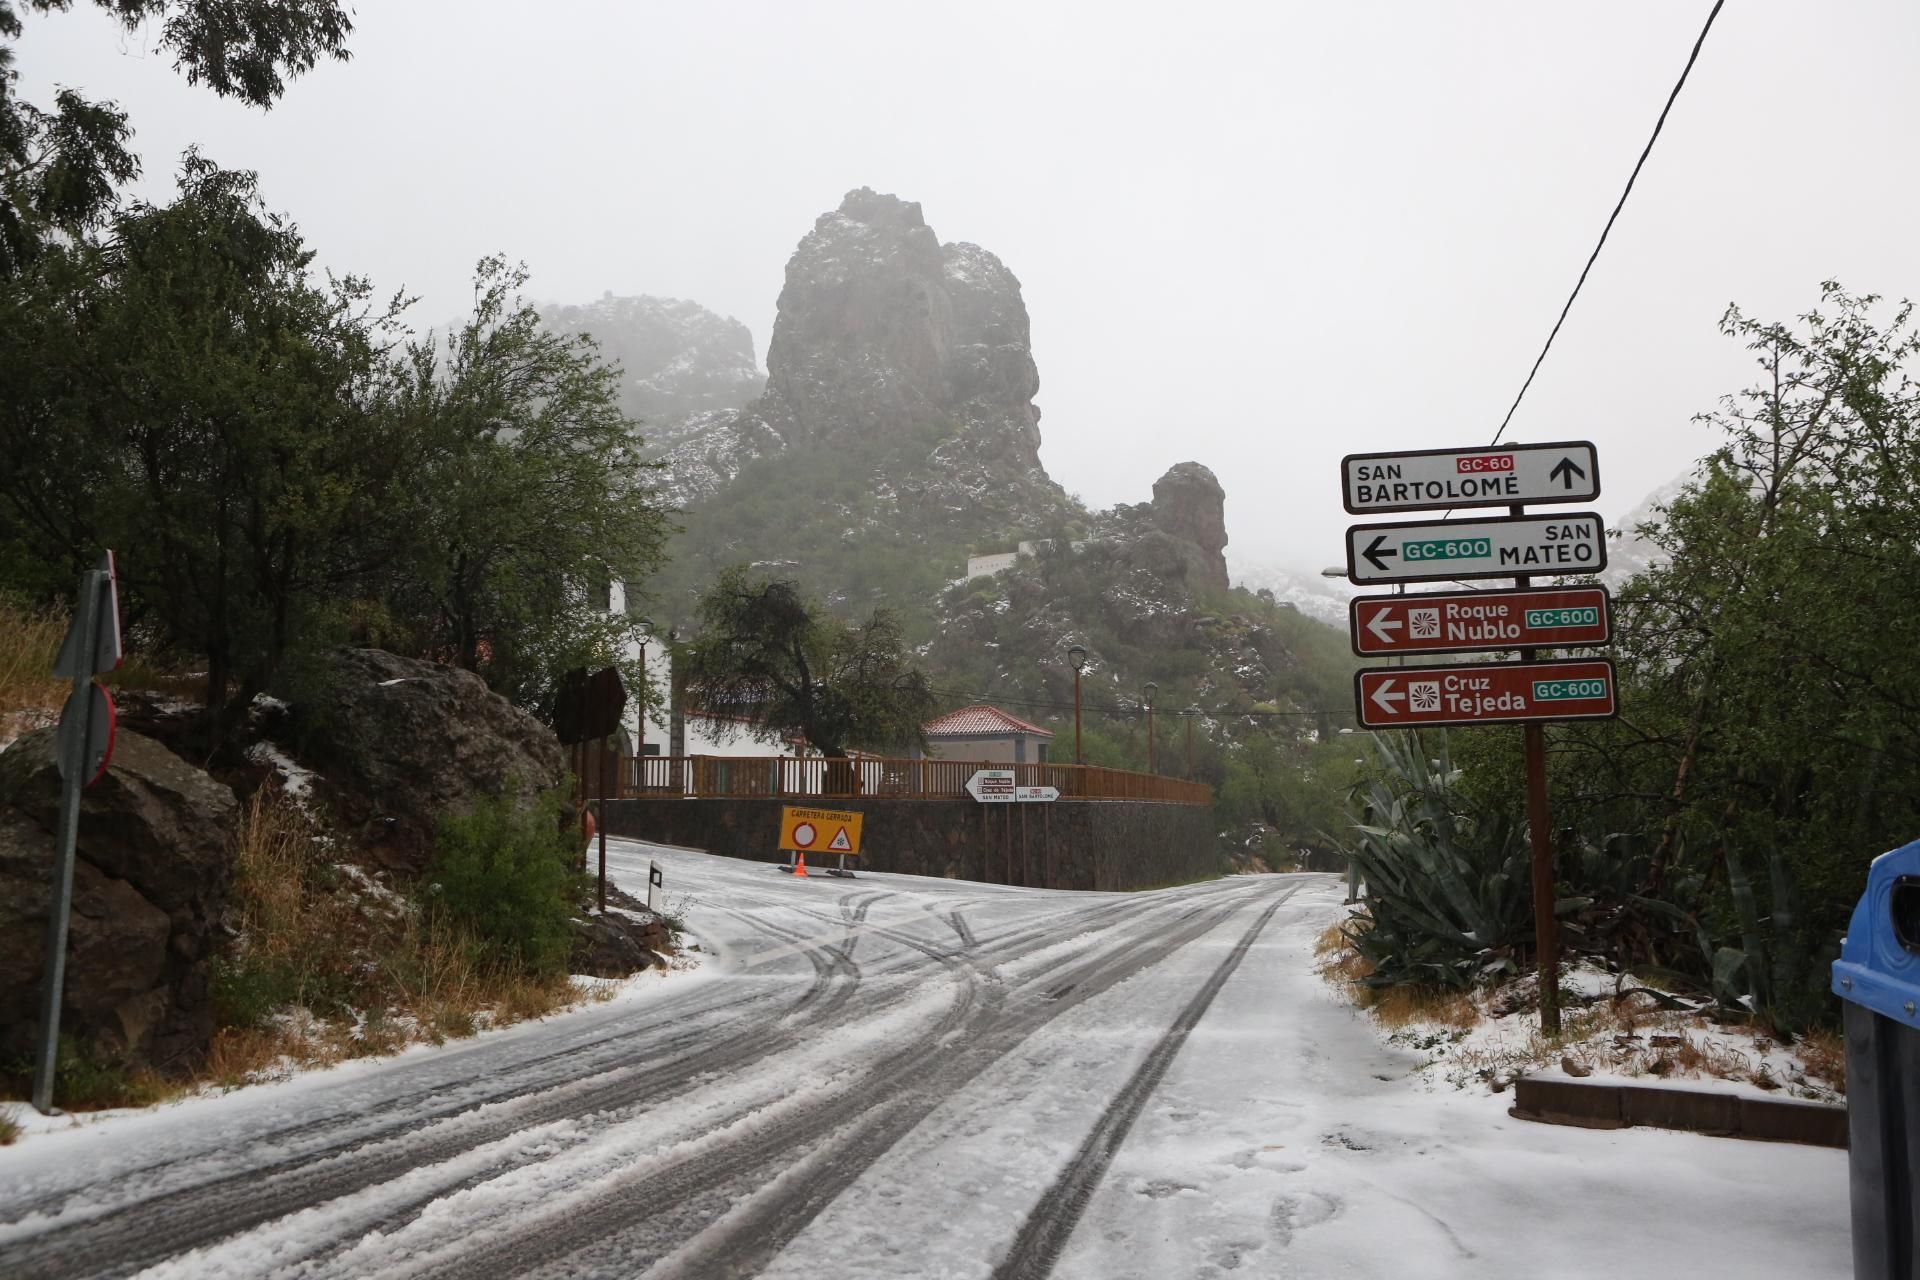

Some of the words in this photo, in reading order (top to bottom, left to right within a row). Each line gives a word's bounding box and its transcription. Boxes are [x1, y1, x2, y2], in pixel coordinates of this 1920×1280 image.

[1357, 464, 1402, 481] SAN
[1459, 457, 1512, 471] GC-60
[1357, 473, 1520, 503] BARTOLOMÉ
[1545, 524, 1590, 541] SAN
[1406, 541, 1489, 559] GC-600
[1500, 543, 1592, 566] MATEO
[1446, 603, 1509, 620] Roque
[1529, 610, 1594, 626] GC-600
[1448, 620, 1521, 641] Nublo
[1445, 675, 1490, 691] Cruz
[1537, 682, 1602, 698] GC-600
[1445, 692, 1526, 715] Tejeda
[791, 809, 825, 819] CARRETERA
[826, 812, 852, 822] CERRADA
